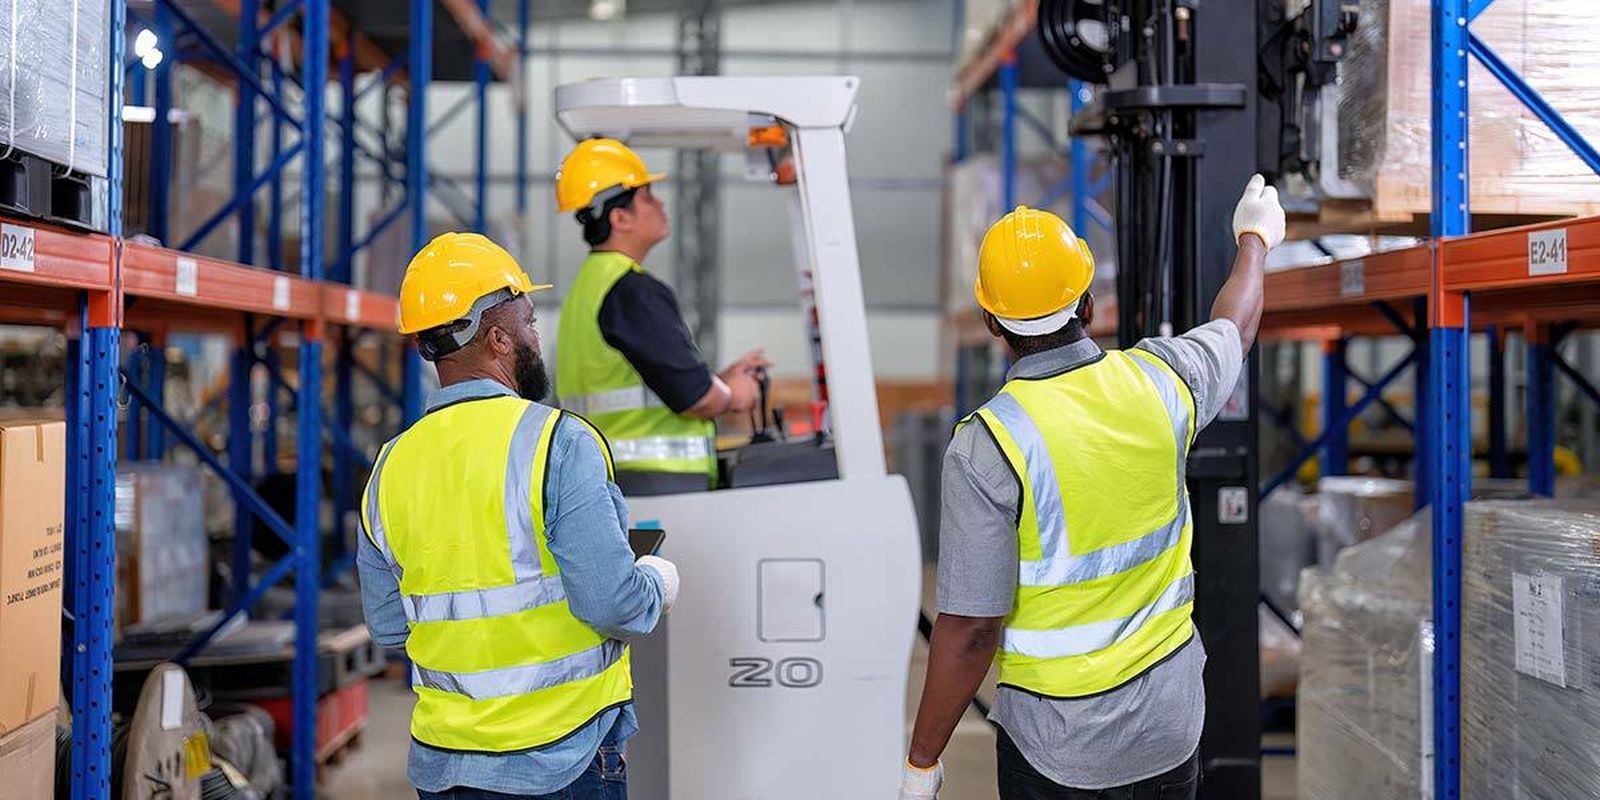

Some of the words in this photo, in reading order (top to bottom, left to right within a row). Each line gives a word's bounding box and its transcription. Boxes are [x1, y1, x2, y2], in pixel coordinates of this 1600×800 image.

[2, 233, 34, 261] D2-42
[1530, 238, 1565, 264] E2-41
[728, 657, 824, 688] 20
